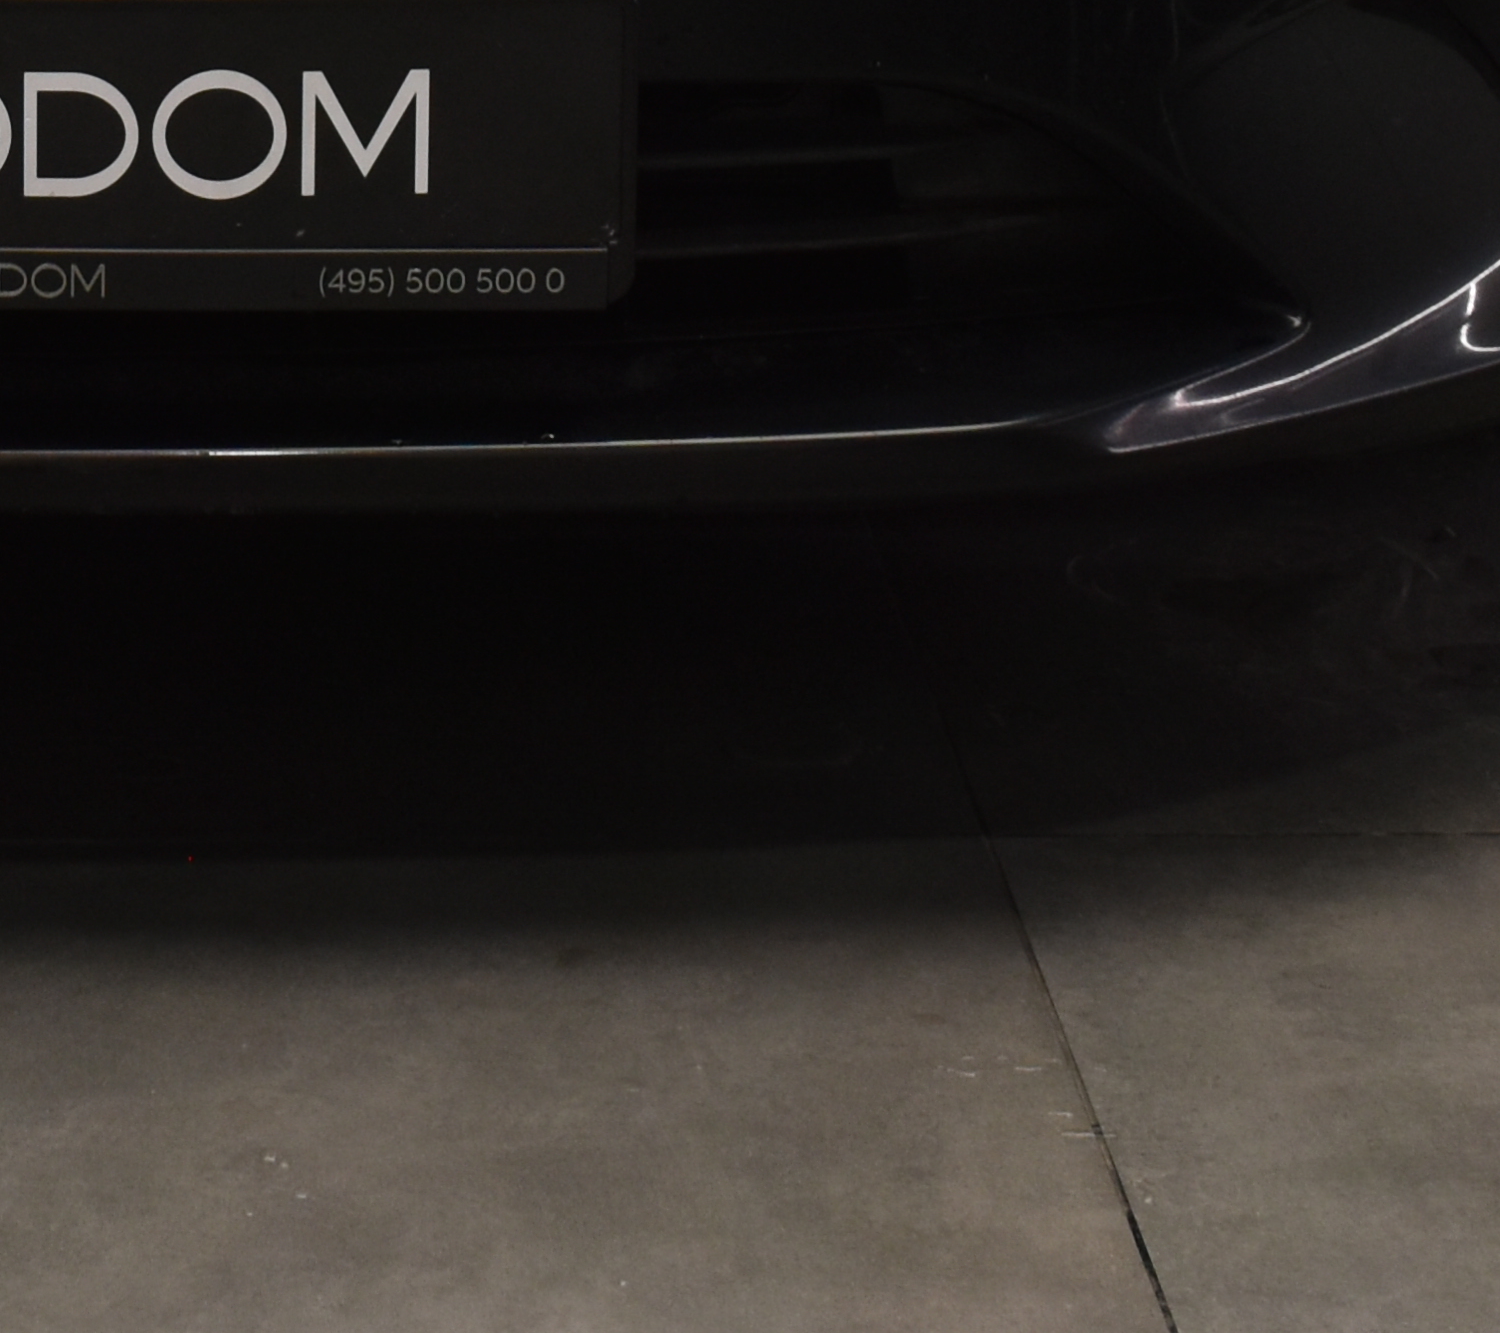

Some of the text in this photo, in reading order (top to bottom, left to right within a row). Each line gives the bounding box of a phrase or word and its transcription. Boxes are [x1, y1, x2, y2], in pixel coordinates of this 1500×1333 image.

[319, 267, 565, 297] (495) 500 500 0
